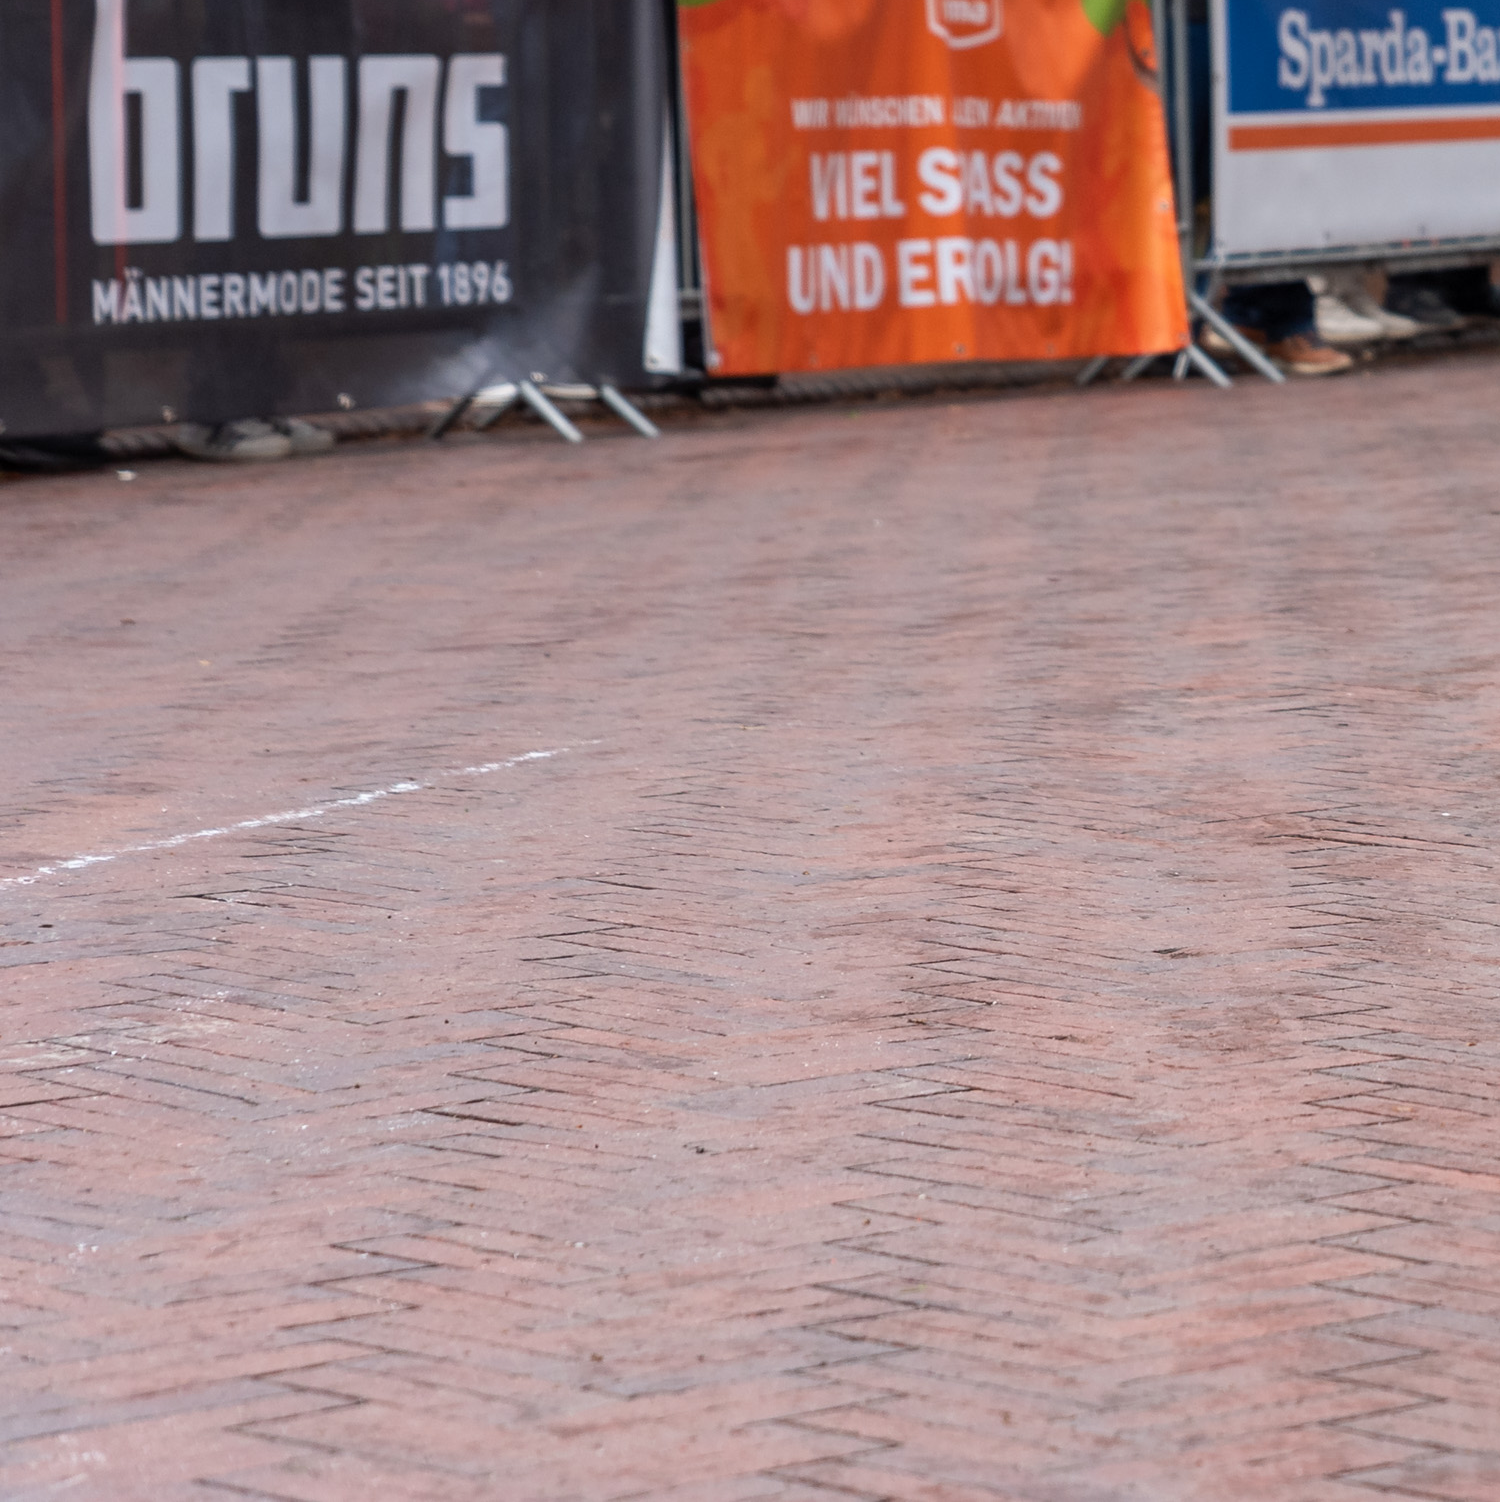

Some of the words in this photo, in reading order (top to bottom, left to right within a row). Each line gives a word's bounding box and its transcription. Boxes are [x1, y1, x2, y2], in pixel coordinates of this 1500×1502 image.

[809, 149, 906, 222] VIEL
[91, 267, 345, 326] MÄNNERMODE
[354, 264, 429, 309] SEIT
[437, 260, 513, 305] 1896
[786, 241, 887, 315] UND
